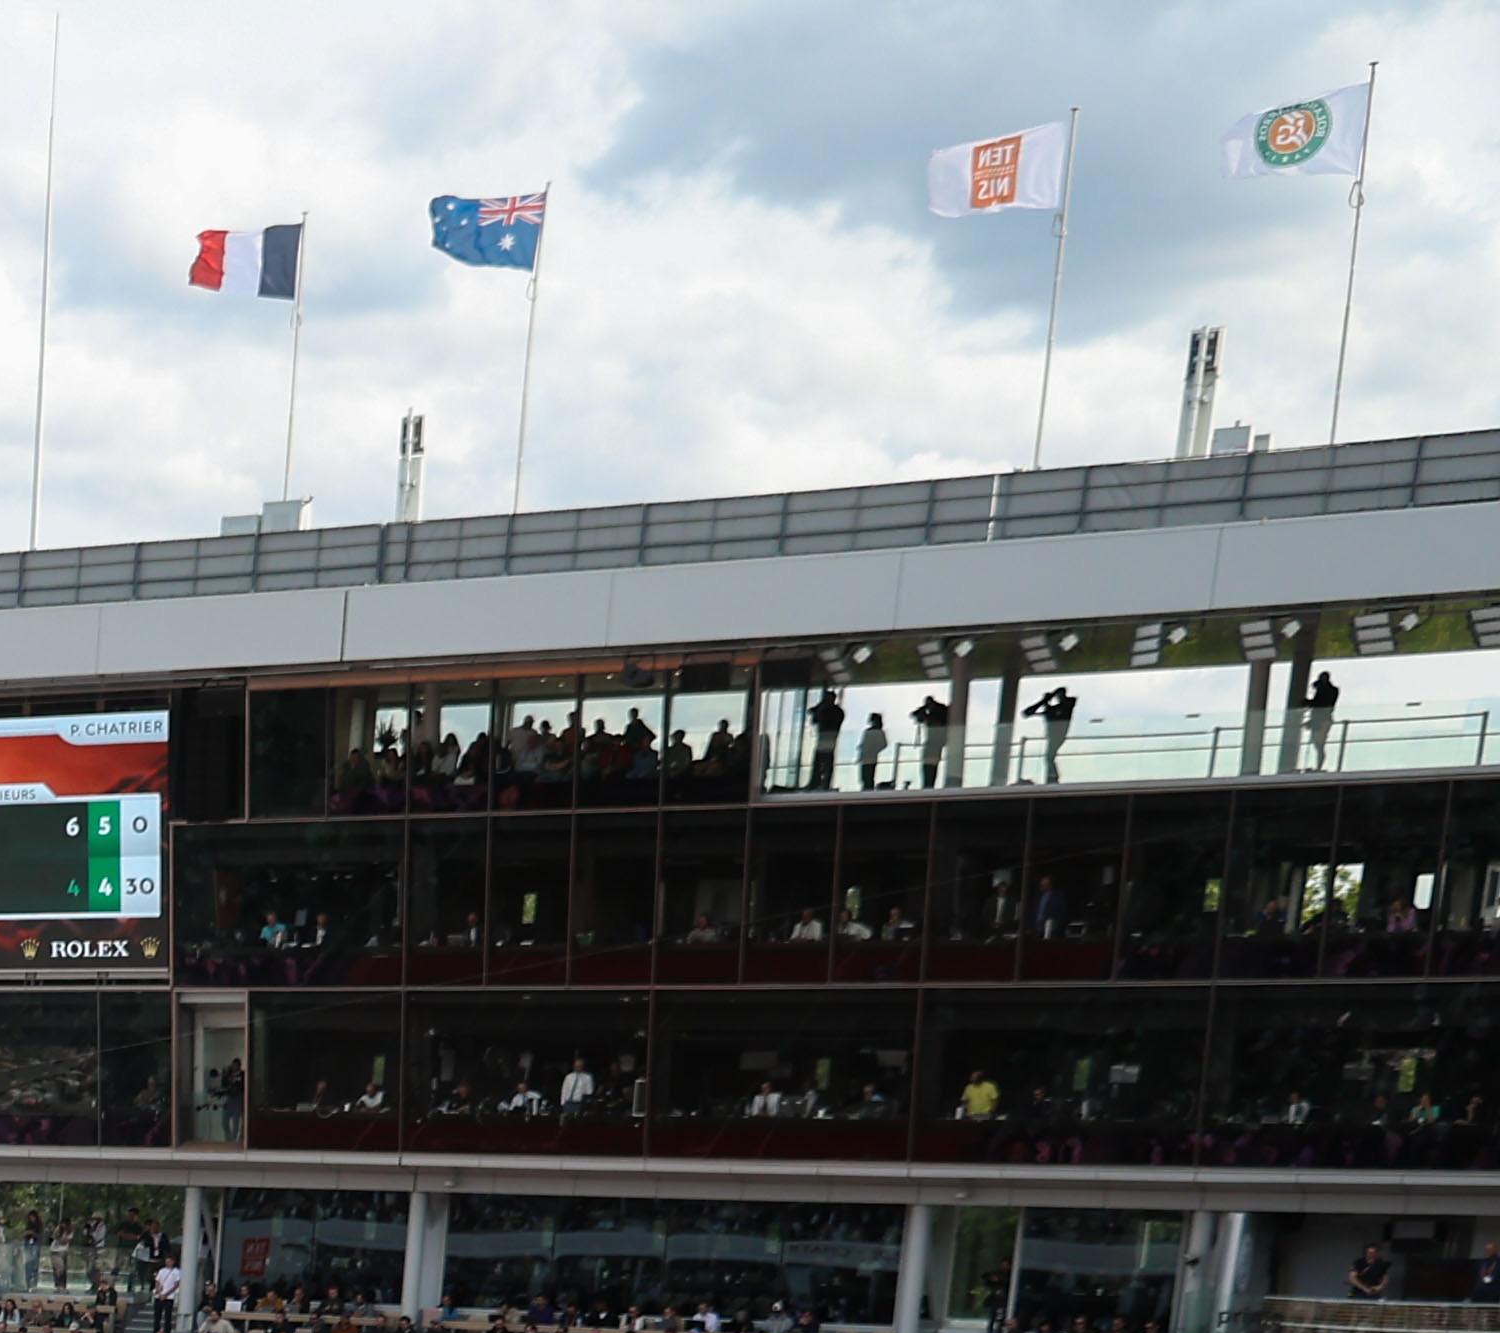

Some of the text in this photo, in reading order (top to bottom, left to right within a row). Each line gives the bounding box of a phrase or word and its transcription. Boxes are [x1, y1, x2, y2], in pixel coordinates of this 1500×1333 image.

[71, 719, 163, 736] P. CHATRIER
[66, 817, 80, 836] 6
[98, 817, 111, 835] 5
[132, 816, 148, 834] 0
[67, 878, 80, 897] 4
[98, 877, 113, 896] 4
[125, 877, 155, 896] 30
[50, 939, 129, 959] ROLEX
